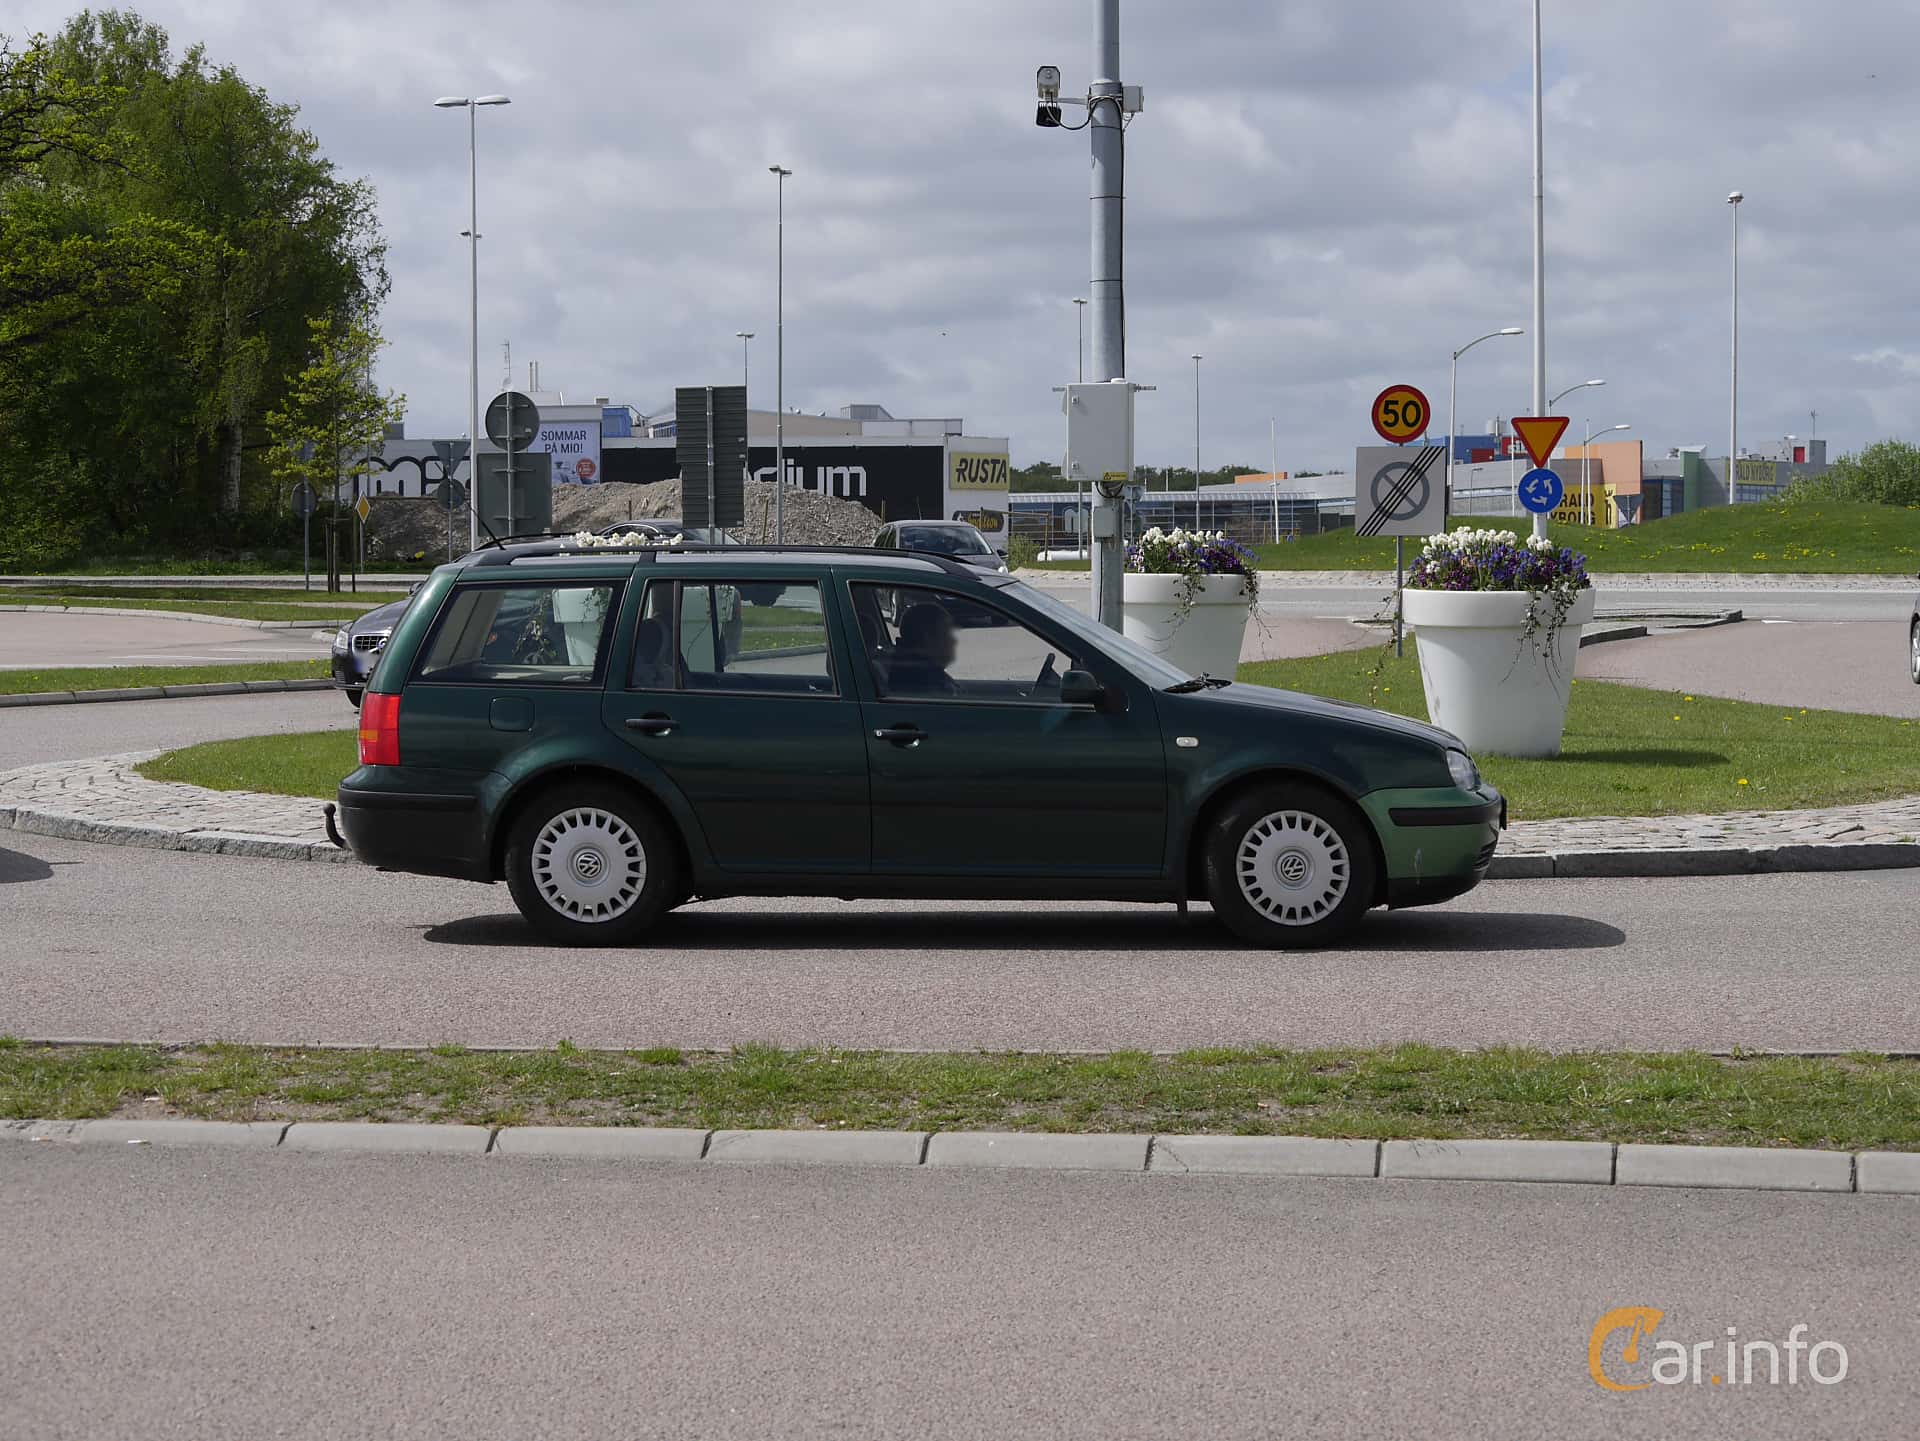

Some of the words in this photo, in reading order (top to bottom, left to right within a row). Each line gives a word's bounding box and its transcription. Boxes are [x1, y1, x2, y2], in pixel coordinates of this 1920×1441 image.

[1382, 399, 1422, 428] 50
[541, 430, 587, 441] SOMMAR
[560, 442, 583, 454] MIO!
[955, 457, 1008, 484] RUSTA
[1559, 493, 1595, 508] RALD
[1548, 511, 1596, 525] YBORG
